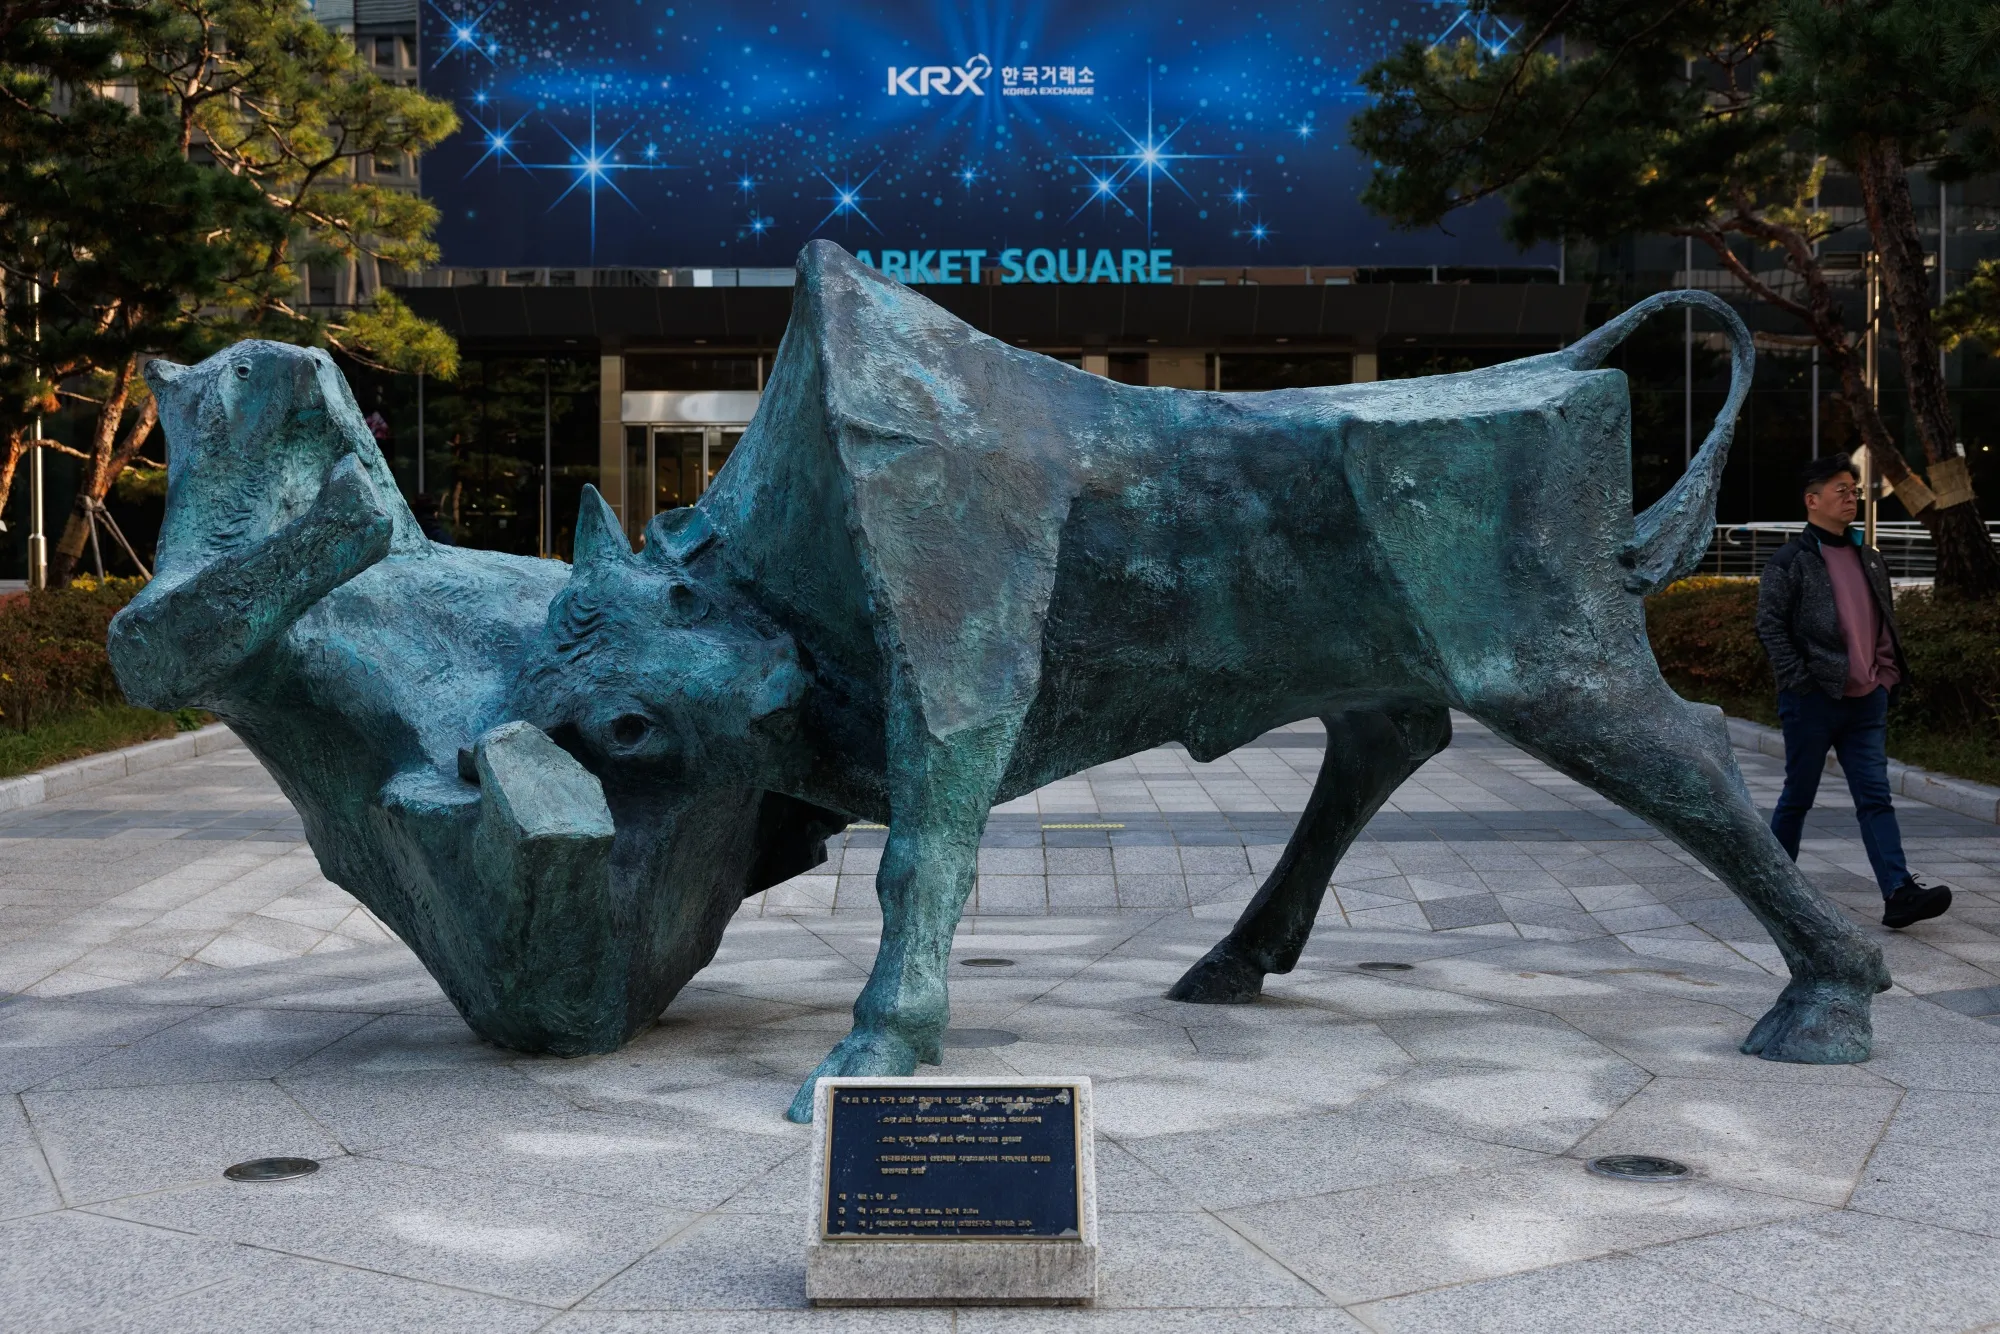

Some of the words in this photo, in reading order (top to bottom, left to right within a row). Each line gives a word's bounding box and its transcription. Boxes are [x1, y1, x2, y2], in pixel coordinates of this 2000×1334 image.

[887, 65, 986, 96] KRX
[1001, 65, 1095, 86] 한국거래소
[1002, 87, 1038, 96] KOREA
[1039, 86, 1094, 96] EXCHANGE
[1000, 248, 1173, 285] SQUARE
